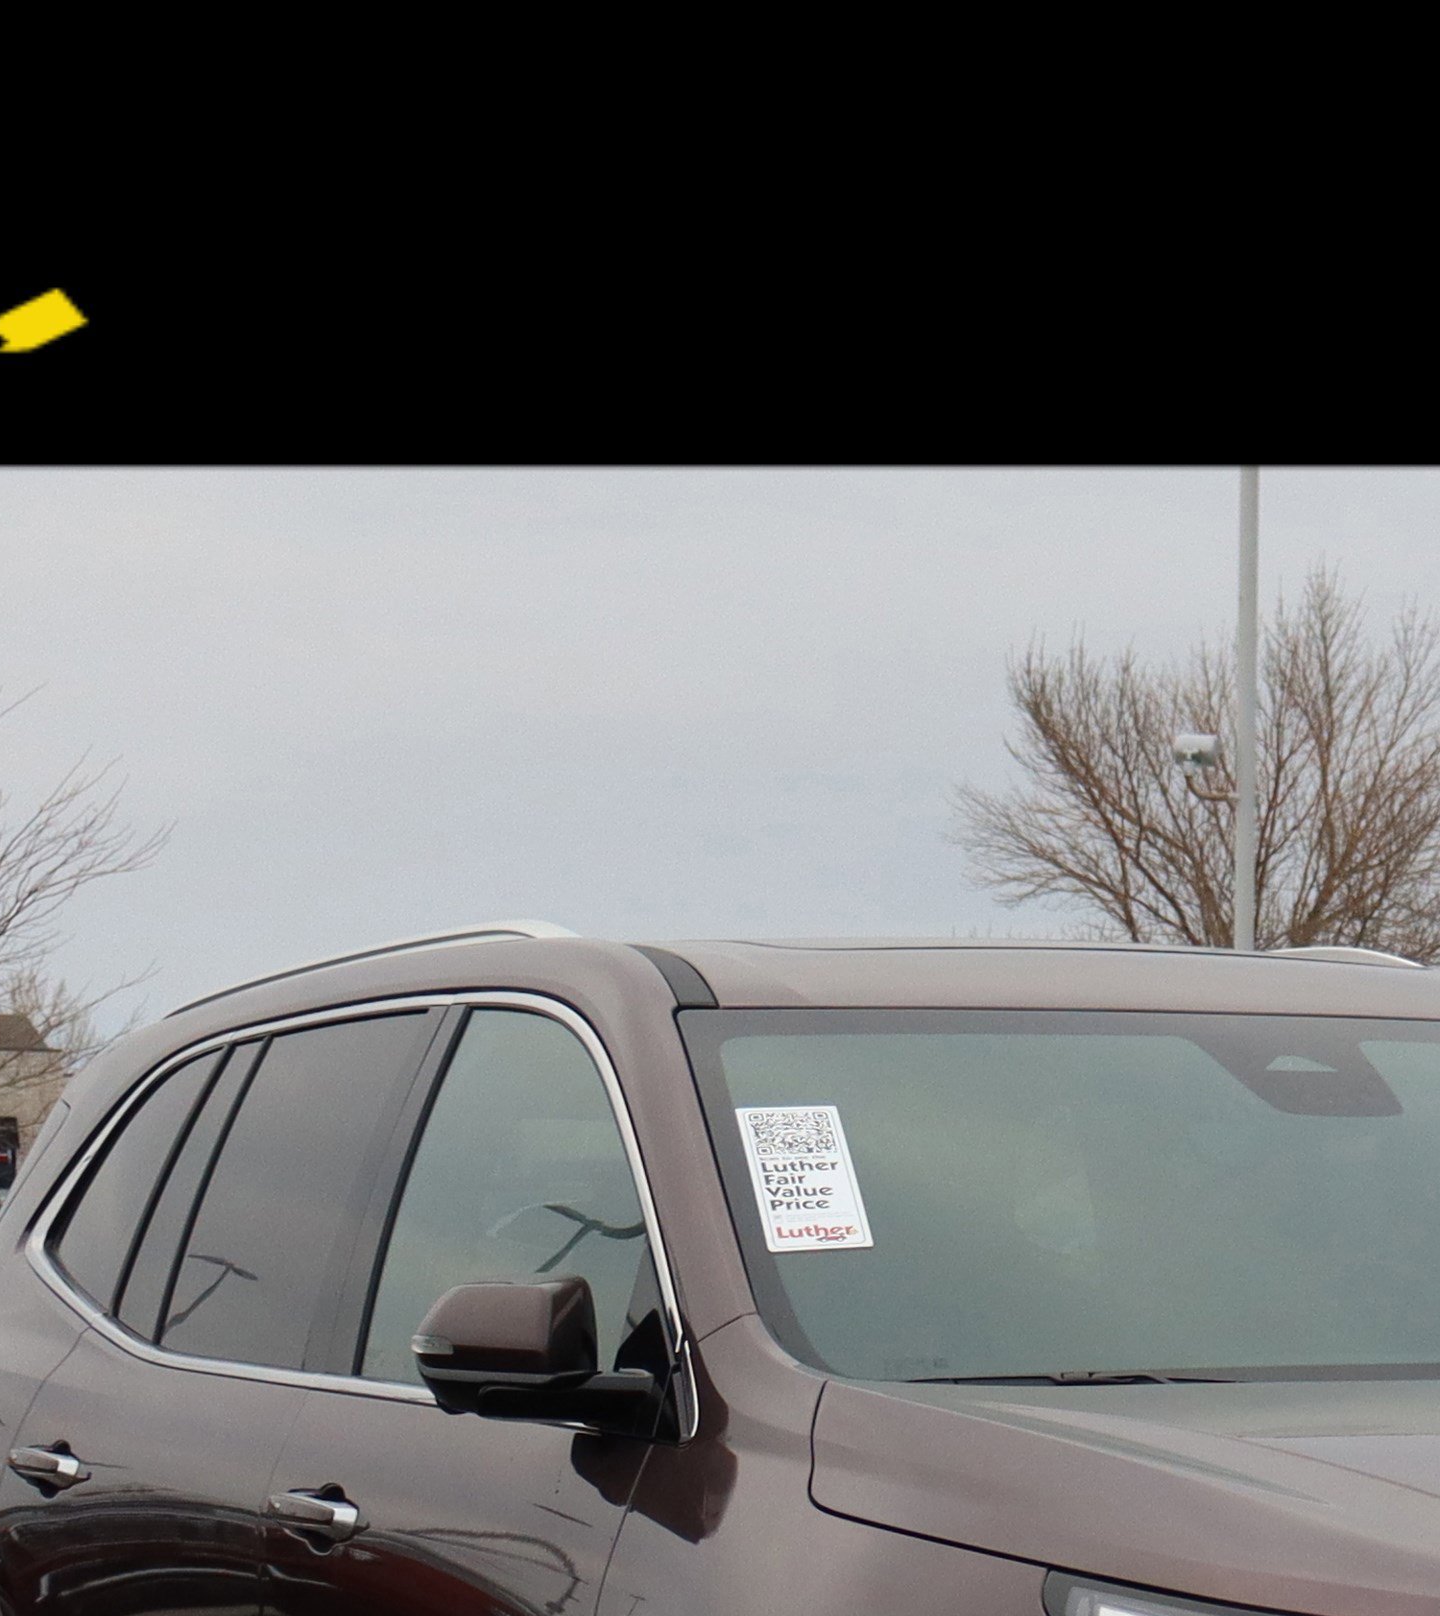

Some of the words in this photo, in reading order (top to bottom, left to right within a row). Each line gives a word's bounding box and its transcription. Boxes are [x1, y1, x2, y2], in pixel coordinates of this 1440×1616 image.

[761, 1161, 838, 1173] Luther
[764, 1173, 806, 1185] Fair
[765, 1186, 833, 1197] Value
[770, 1198, 830, 1211] Price
[776, 1224, 853, 1239] Luther
